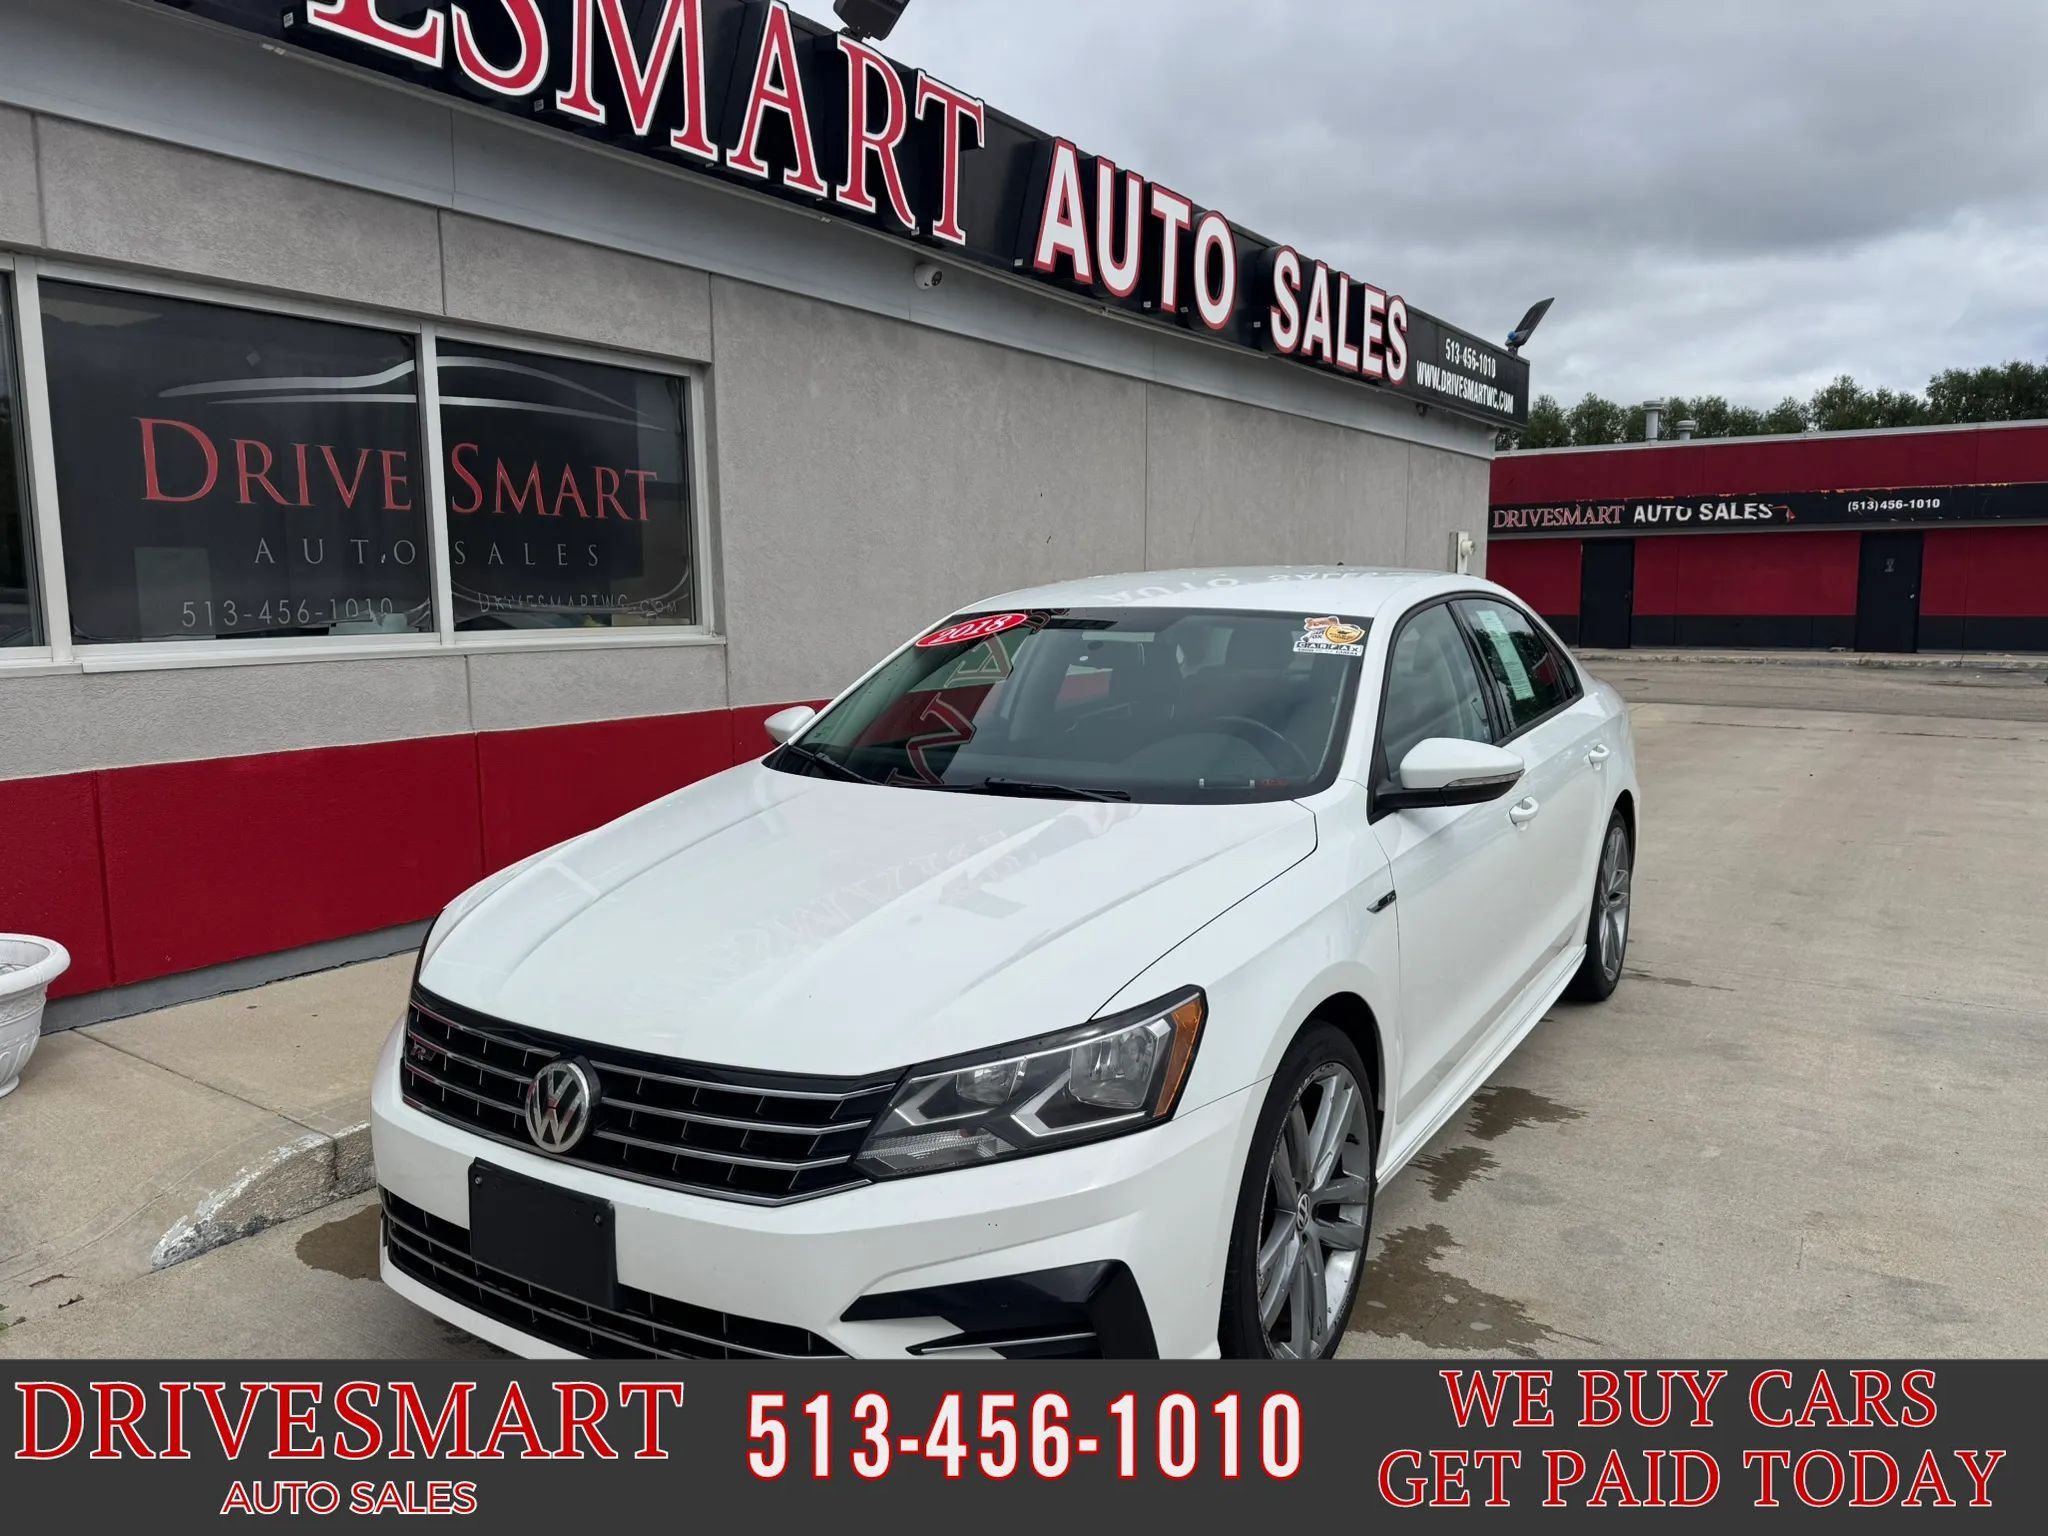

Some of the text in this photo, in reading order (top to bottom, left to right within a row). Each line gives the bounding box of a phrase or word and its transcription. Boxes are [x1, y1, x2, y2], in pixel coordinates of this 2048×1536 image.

[307, 0, 1408, 385] MART AUTO SALES
[1445, 338, 1497, 379] 513-456-1010
[1493, 502, 1773, 529] DRIVESMART AUTO SALES
[254, 538, 600, 567] AUTO SALES
[928, 615, 1013, 645] 2018
